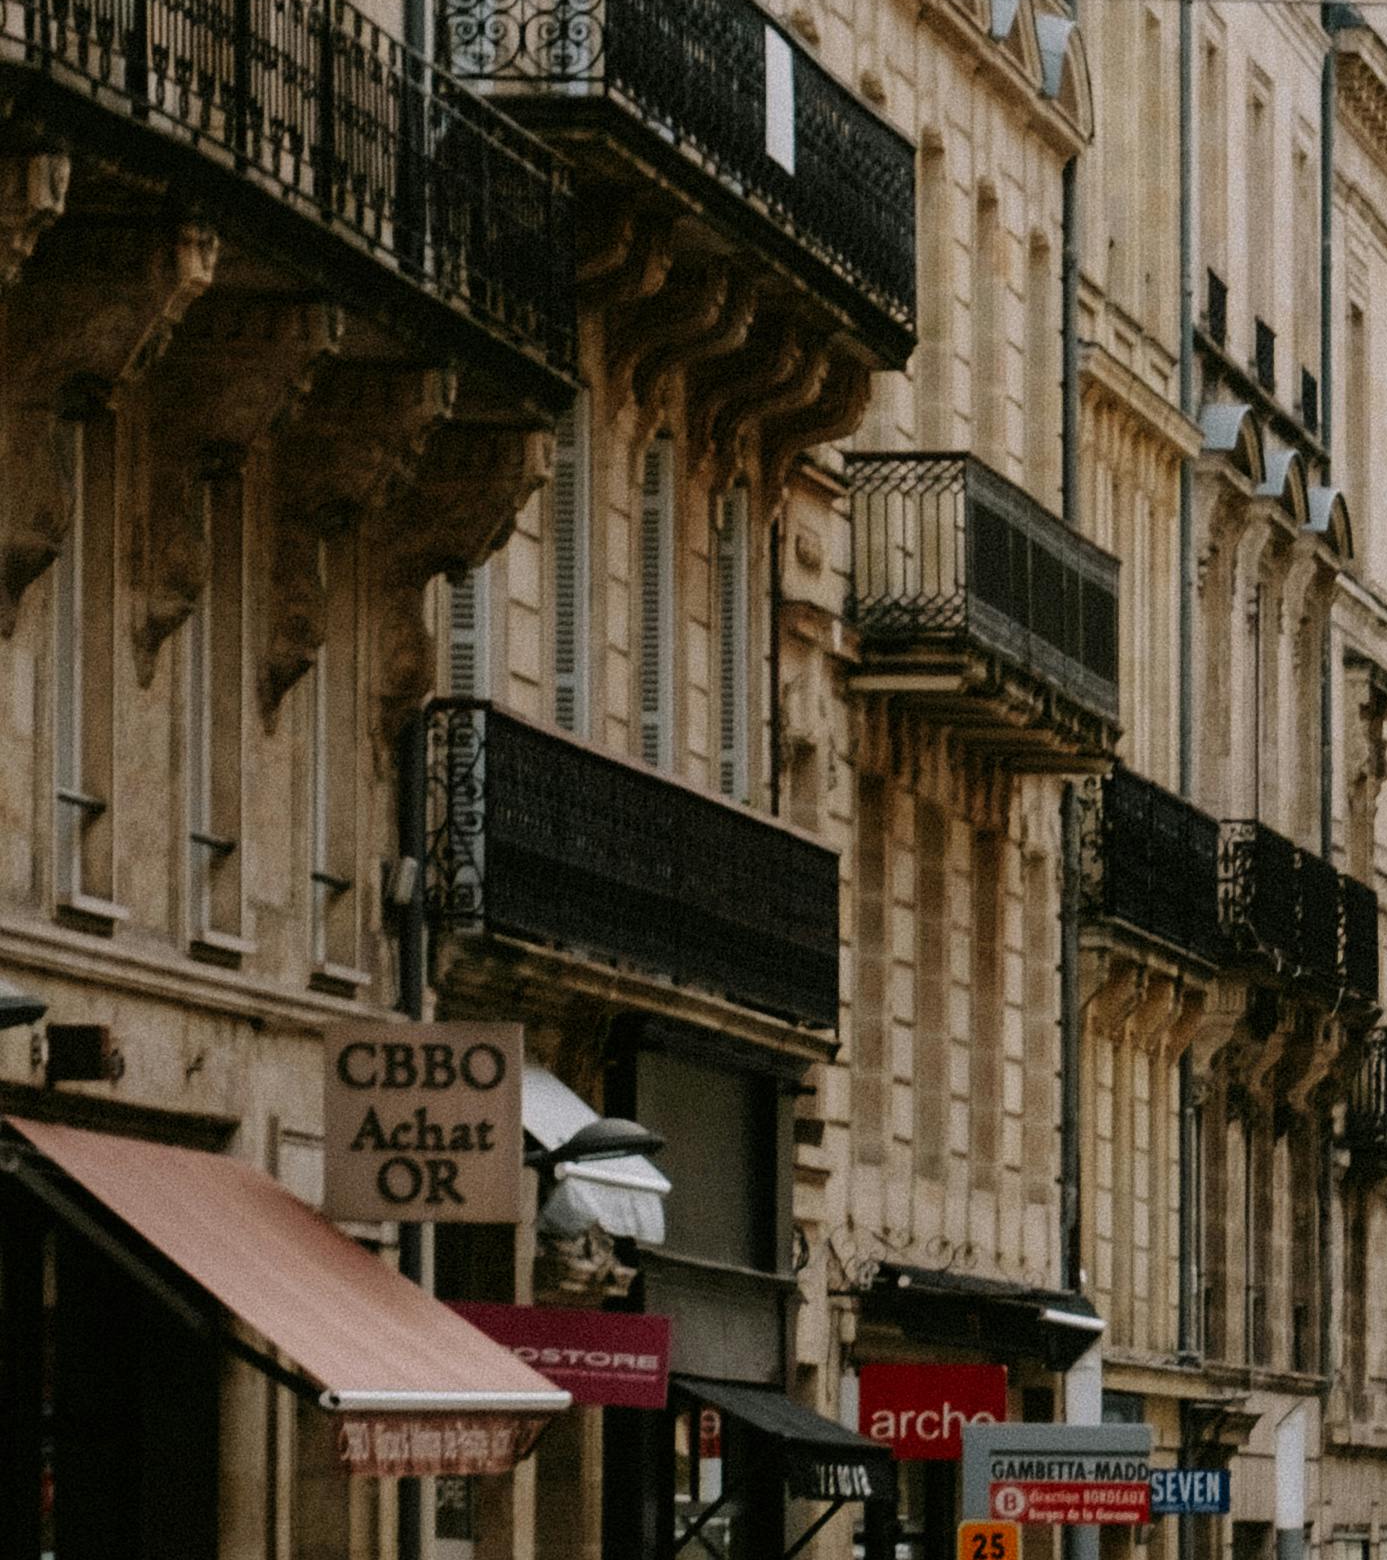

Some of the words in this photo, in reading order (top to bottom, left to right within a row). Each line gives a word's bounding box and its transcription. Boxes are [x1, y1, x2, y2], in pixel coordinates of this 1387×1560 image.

[335, 1042, 506, 1093] CBBO
[350, 1105, 496, 1153] Achat
[376, 1156, 466, 1208] OR
[512, 1346, 659, 1371] OSTORE
[1002, 1491, 1019, 1512] B
[1082, 1489, 1146, 1506] BORDEAUX
[1151, 1470, 1221, 1504] SEVEN
